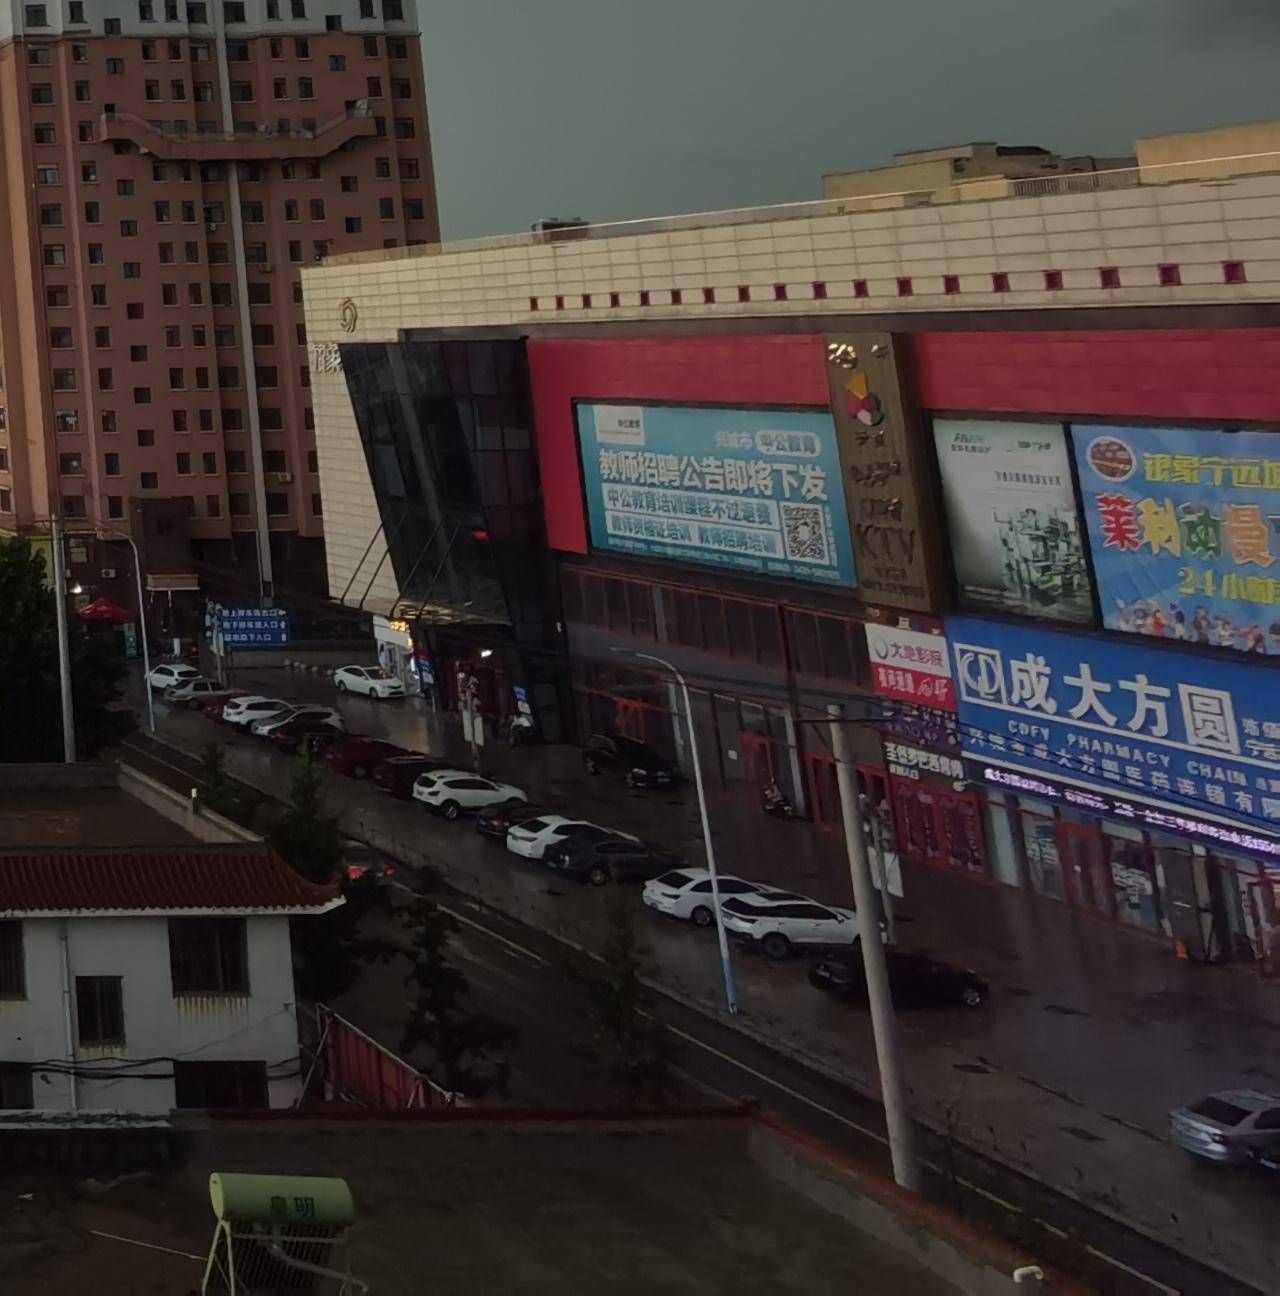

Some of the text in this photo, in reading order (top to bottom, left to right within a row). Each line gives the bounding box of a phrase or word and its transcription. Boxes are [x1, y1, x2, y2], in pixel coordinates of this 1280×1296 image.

[599, 449, 828, 502] 教师招聘公告即将下发
[1009, 652, 1240, 755] 成大方圆
[1066, 732, 1172, 768] PHARMACY
[1186, 760, 1248, 787] CHAIN
